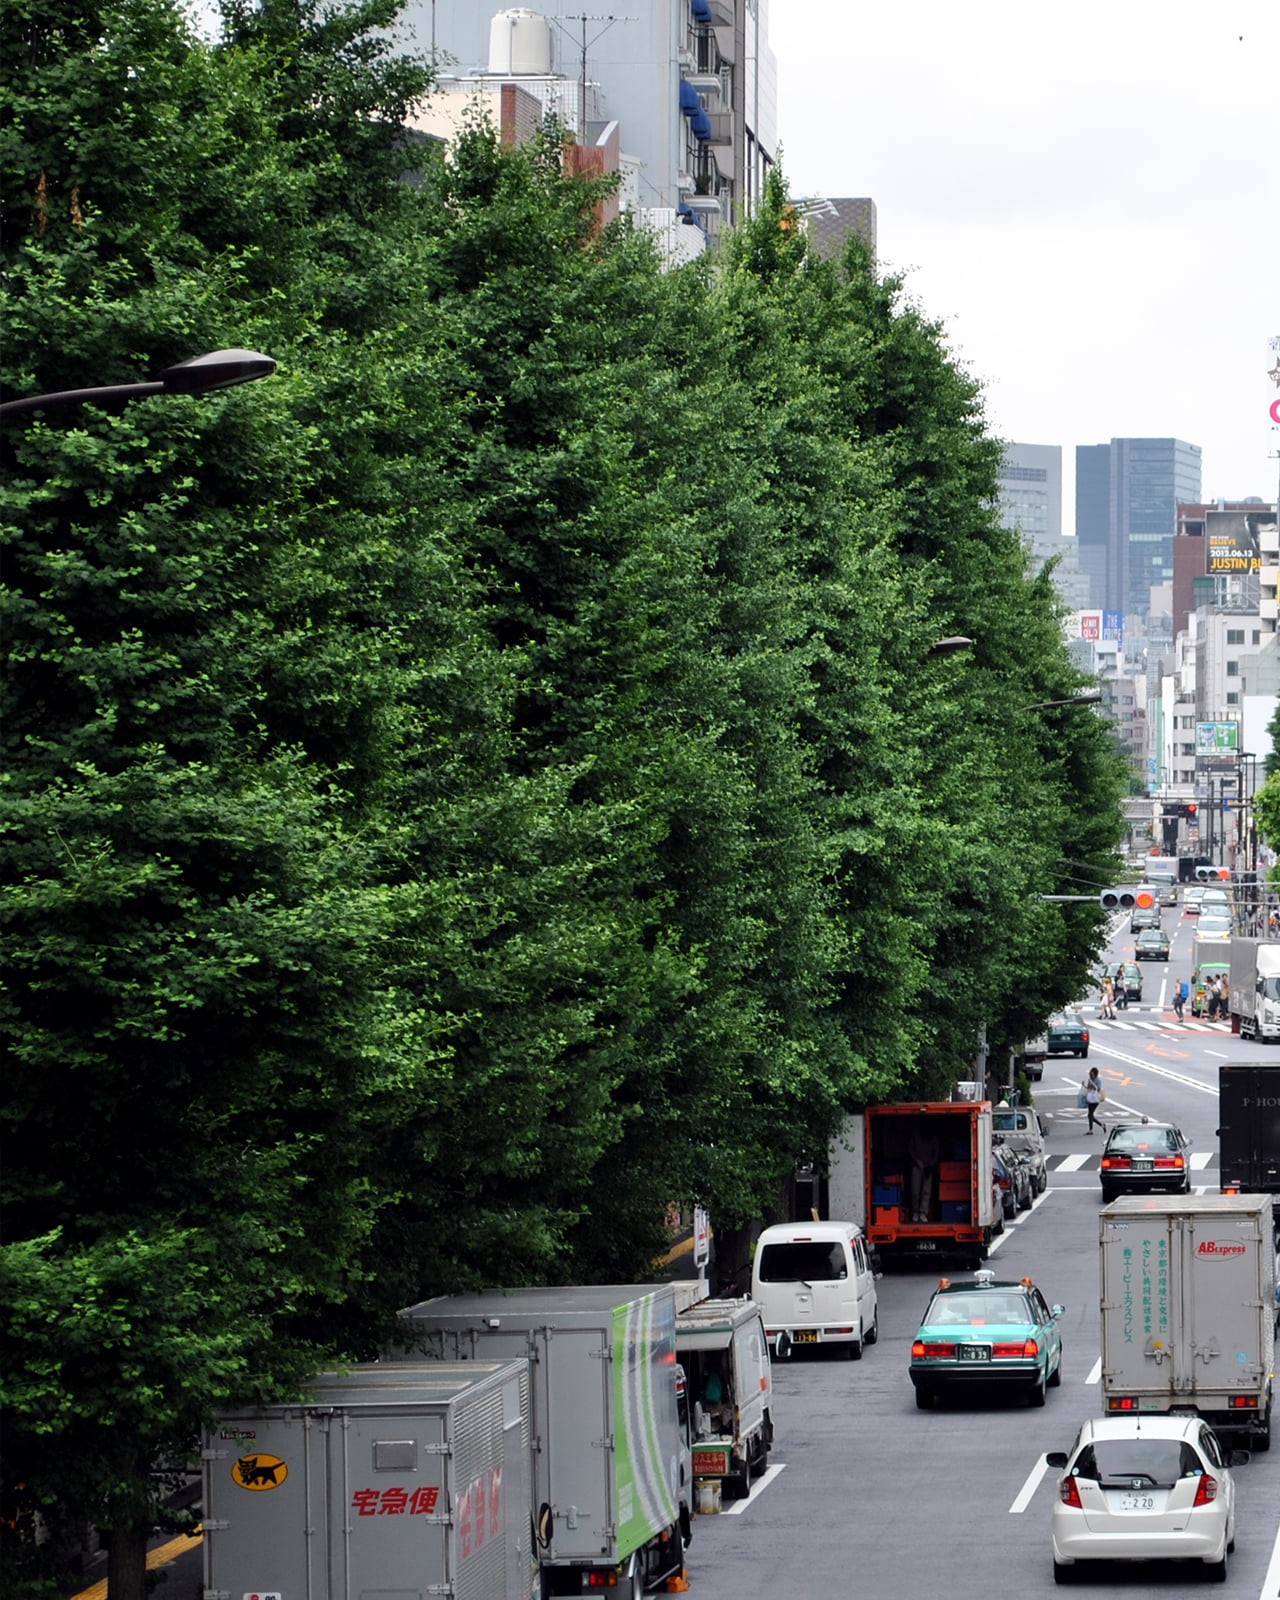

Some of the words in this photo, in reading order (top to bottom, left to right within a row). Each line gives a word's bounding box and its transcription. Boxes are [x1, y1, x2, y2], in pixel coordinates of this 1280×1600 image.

[1210, 558, 1248, 569] JUSTIN
[351, 1487, 440, 1517] 宅急便
